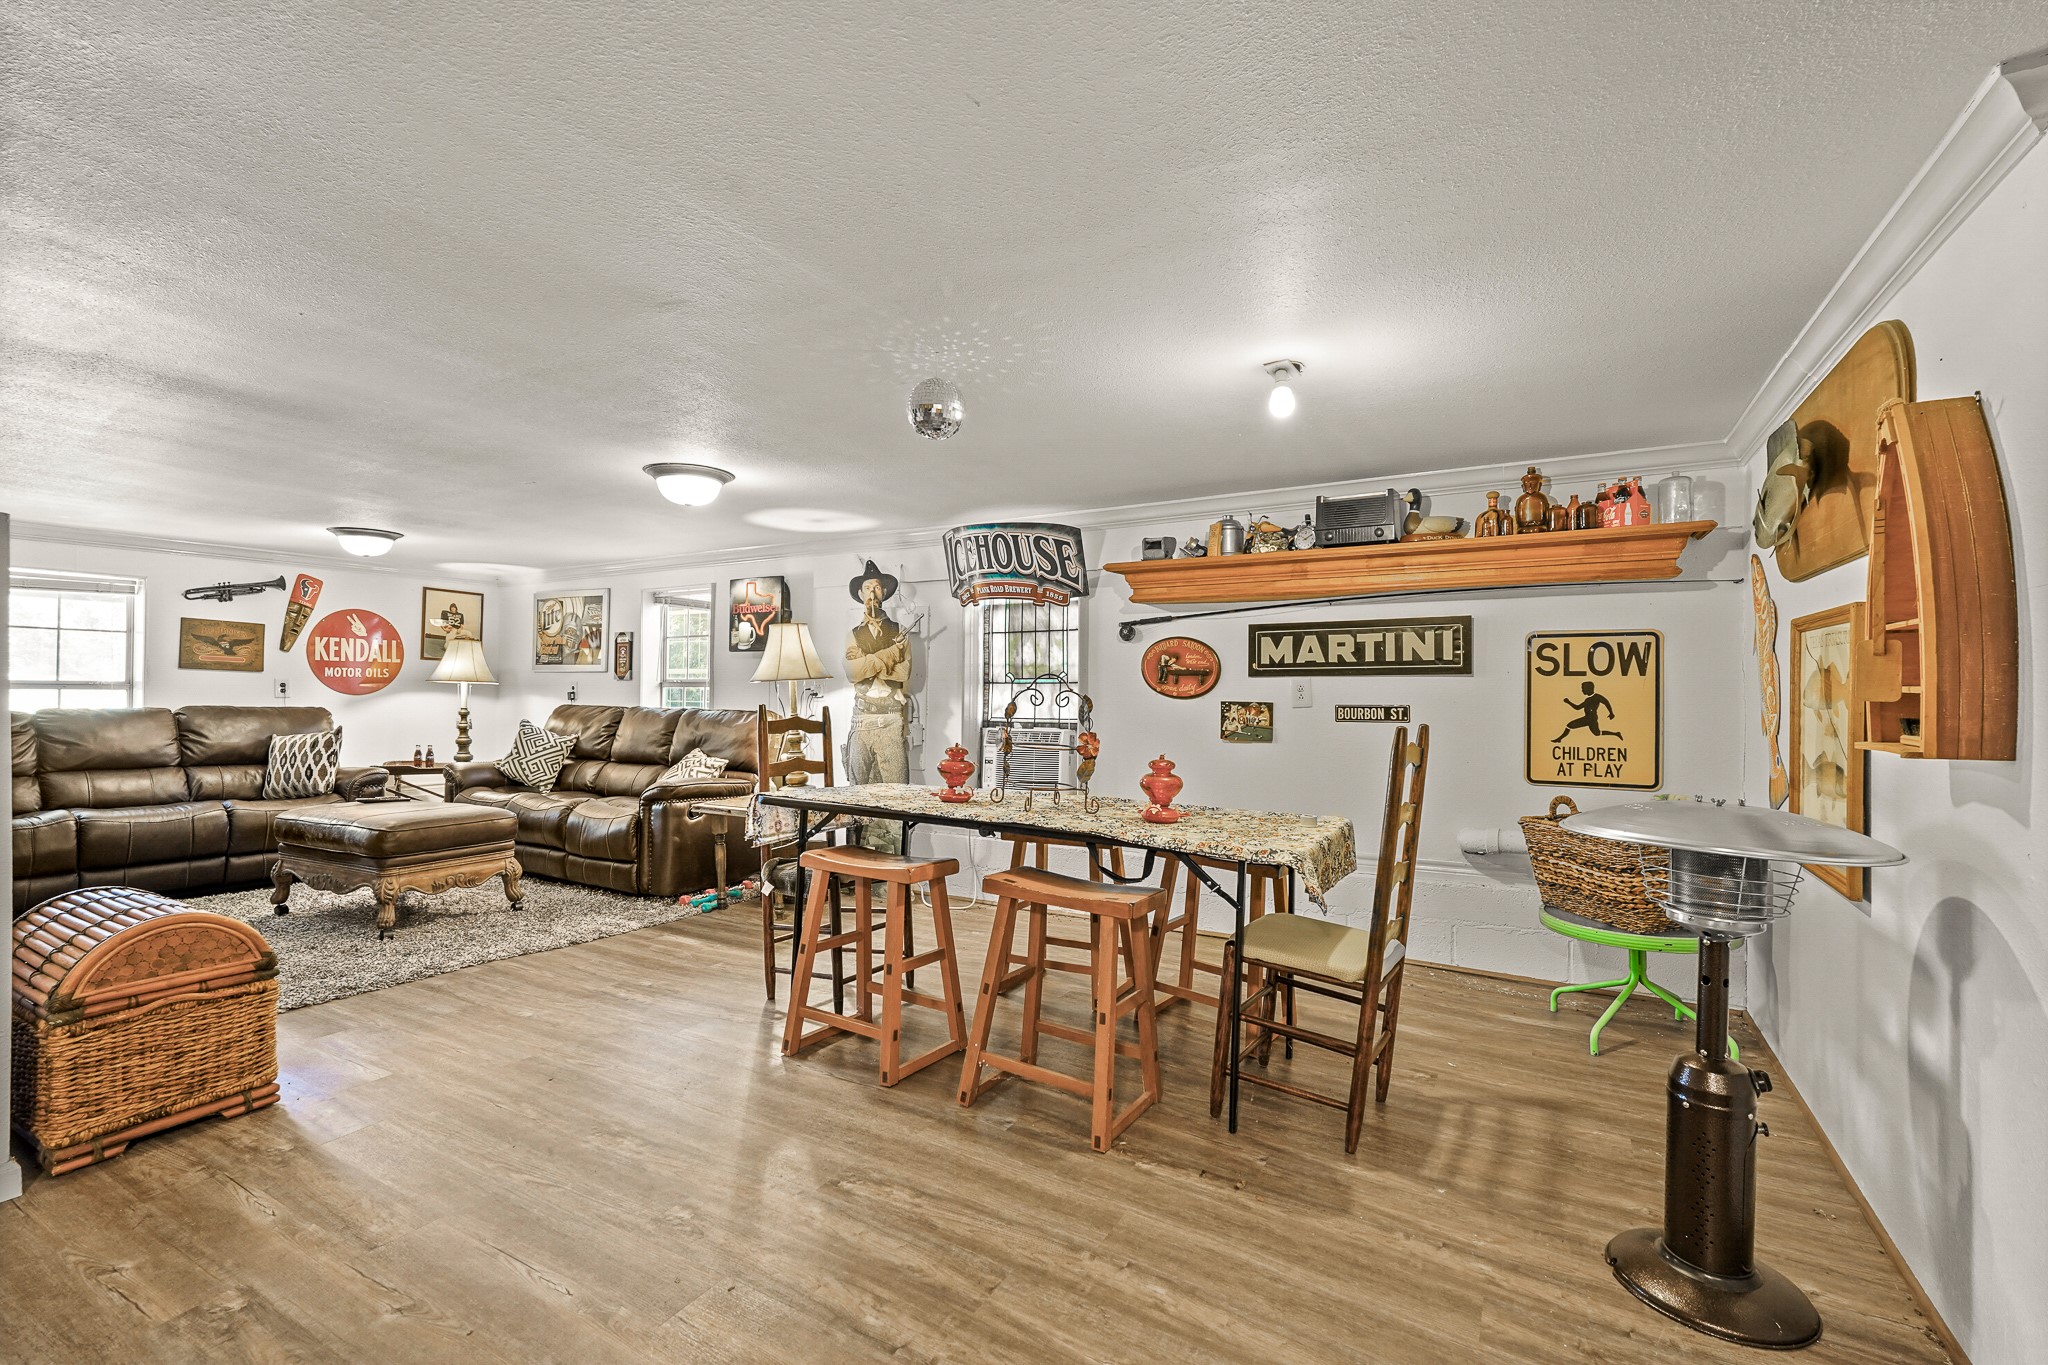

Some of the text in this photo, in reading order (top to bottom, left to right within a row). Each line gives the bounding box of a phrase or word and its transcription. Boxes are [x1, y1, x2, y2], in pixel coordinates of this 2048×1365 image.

[947, 532, 1082, 591] ICEHOUSE
[976, 585, 1033, 594] PLANK ROAD BREWERY
[1045, 591, 1064, 601] 1855
[732, 603, 779, 614] Budweiser
[448, 616, 461, 626] 52
[543, 608, 560, 630] Lite
[315, 636, 400, 662] KENDALL
[1261, 629, 1453, 664] MARTINI
[1535, 641, 1652, 676] SLOW
[324, 667, 390, 678] MOTOR OILS
[1337, 707, 1408, 720] BOURBON ST.
[1552, 746, 1628, 762] CHILDREN
[1556, 763, 1624, 778] AT PLAY
